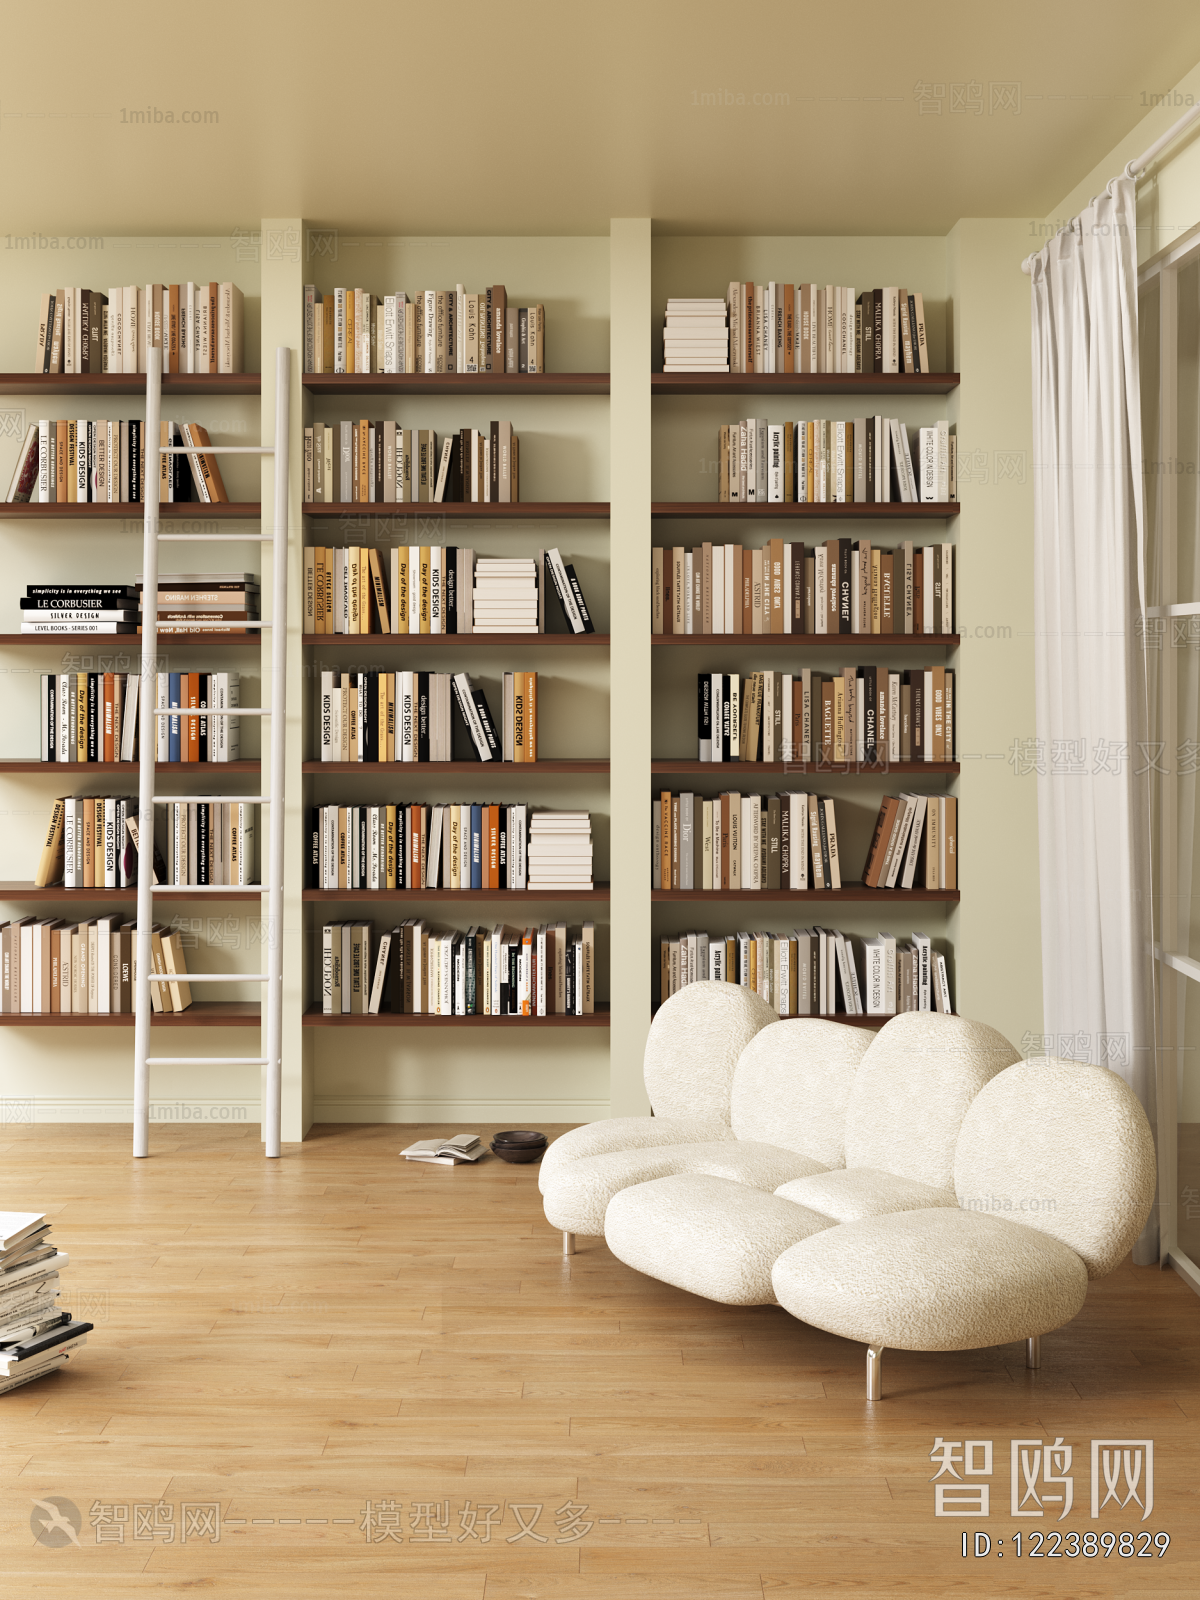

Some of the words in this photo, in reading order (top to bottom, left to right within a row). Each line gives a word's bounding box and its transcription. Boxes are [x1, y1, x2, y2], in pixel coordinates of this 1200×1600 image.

[385, 298, 395, 317] Elliott
[874, 302, 882, 331] MALLIKA
[385, 319, 395, 340] Erwitt
[383, 341, 395, 366] Snaps
[874, 334, 882, 360] CHOPRA
[39, 435, 48, 445] LE
[740, 426, 748, 446] Zaha
[78, 442, 86, 458] KIDS
[740, 449, 748, 471] Hadid
[39, 446, 48, 491] CORBUSIER
[78, 461, 86, 489] DESIGN
[399, 563, 407, 576] Day
[432, 569, 440, 587] KIDS
[447, 569, 455, 589] design
[374, 576, 385, 607] MINIMALISM
[399, 586, 407, 597] the
[37, 600, 49, 608] LE
[50, 600, 103, 608] CORBUSIER
[399, 599, 407, 621] design
[432, 589, 440, 618] DESIGN
[323, 695, 331, 713] KIDS
[404, 695, 412, 713] KIDS
[419, 695, 428, 715] design
[879, 691, 887, 714] amanda
[935, 689, 943, 703] GOOD
[945, 700, 952, 708] IN
[824, 700, 832, 745] BAGUETTE
[935, 706, 943, 721] VIBES
[323, 716, 331, 745] DESIGN
[404, 716, 412, 745] DESIGN
[866, 709, 875, 748] CHANEL
[879, 715, 887, 740] lovelace
[935, 724, 943, 737] ONLY
[51, 804, 62, 823] DESIGN
[66, 815, 74, 825] LE
[106, 822, 114, 840] KIDS
[682, 823, 692, 842] Dior
[781, 810, 789, 842] MALLIKA
[45, 825, 57, 848] FESTIVAL
[771, 838, 779, 853] STILL
[829, 833, 837, 858] PRADA
[66, 826, 74, 874] CORBUSIER
[106, 842, 114, 871] DESIGN
[781, 845, 789, 873] CHOPRA
[680, 945, 688, 965] Zaha
[780, 942, 789, 962] Elliott
[872, 949, 881, 964] WHITE
[780, 964, 789, 986] Erwitt
[872, 965, 881, 982] COLOR
[780, 988, 789, 1013] Snaps
[872, 990, 881, 1008] DESIGN
